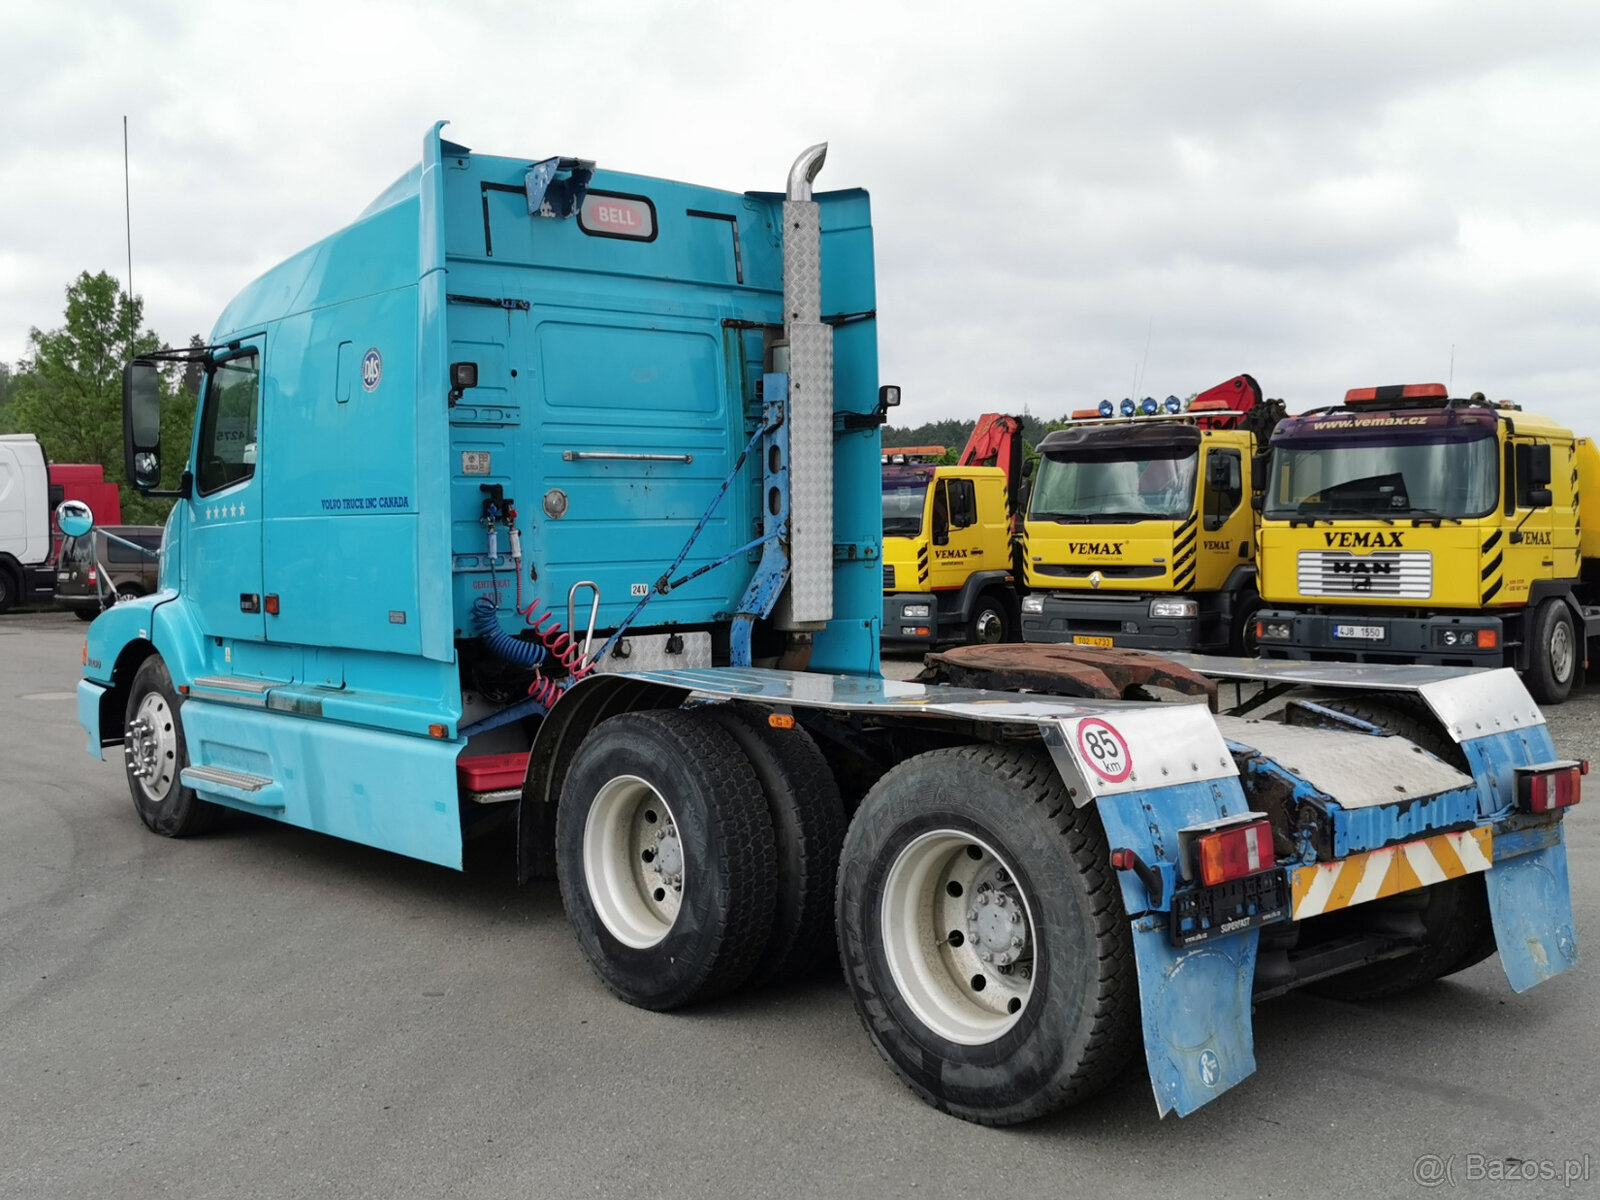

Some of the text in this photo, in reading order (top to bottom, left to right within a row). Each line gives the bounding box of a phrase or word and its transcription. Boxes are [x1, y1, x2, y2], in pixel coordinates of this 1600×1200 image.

[599, 206, 636, 225] BELL
[364, 357, 380, 382] DAS
[1314, 416, 1428, 430] www.vemax.cz
[321, 496, 409, 510] VOLVO TRUCK INC CANADA
[1324, 532, 1405, 547] VEMAX
[935, 549, 967, 559] VEMAX
[1068, 542, 1123, 555] VEMAX
[1334, 562, 1390, 573] MAN
[1361, 628, 1380, 637] 1550
[1085, 730, 1118, 760] 85
[1102, 760, 1122, 773] km
